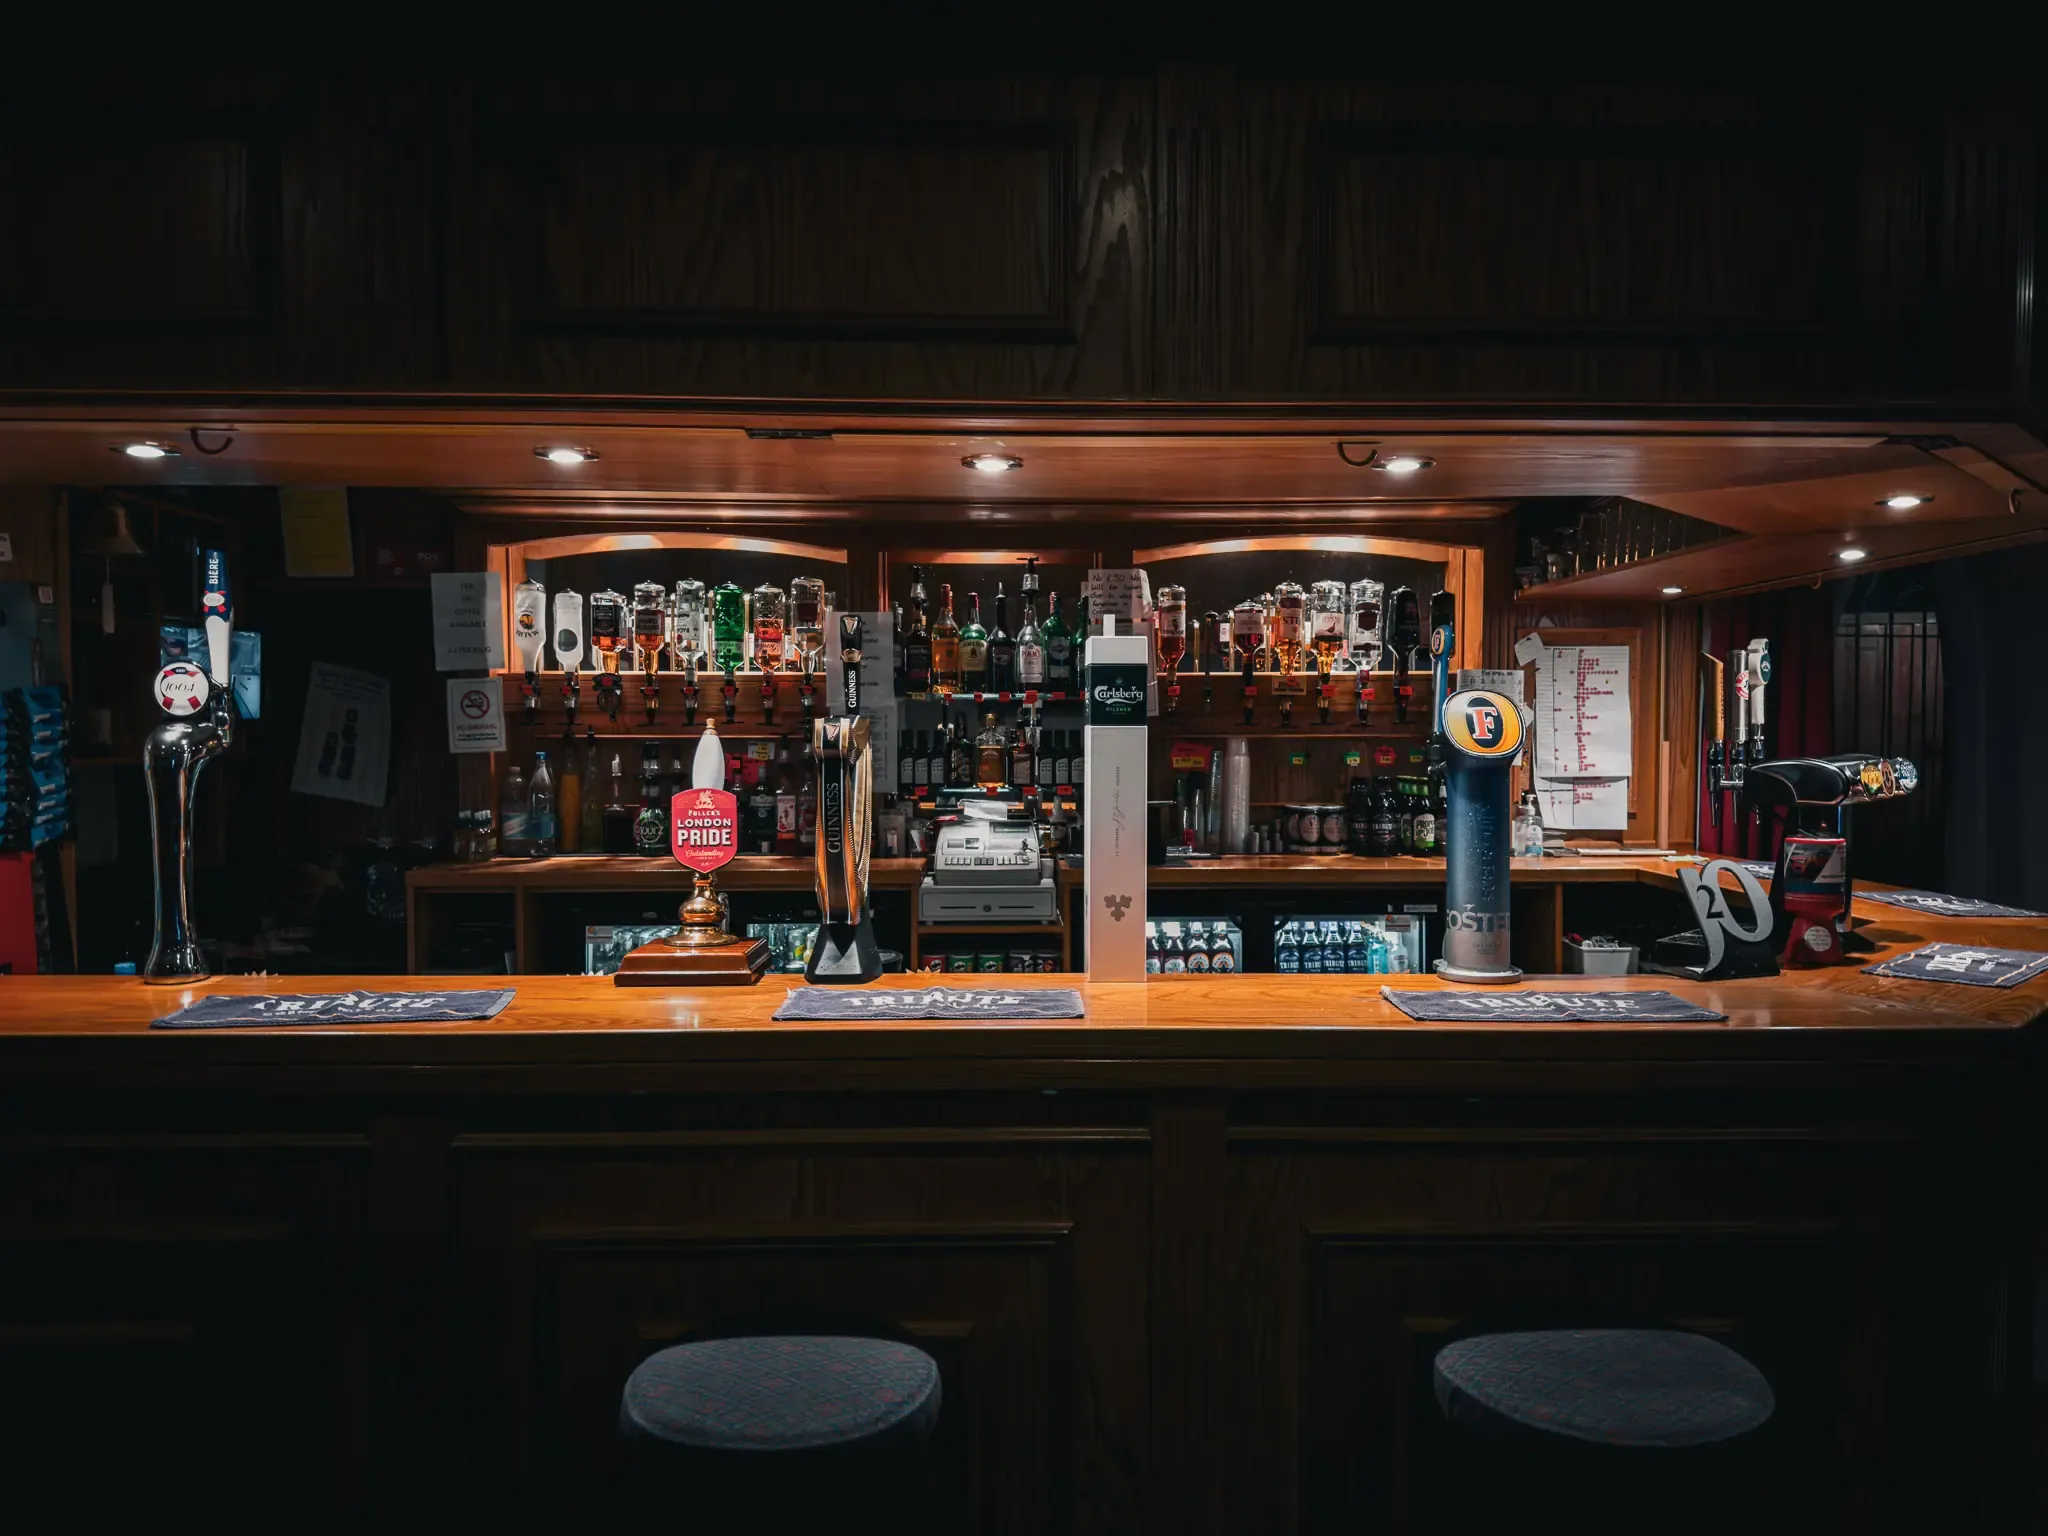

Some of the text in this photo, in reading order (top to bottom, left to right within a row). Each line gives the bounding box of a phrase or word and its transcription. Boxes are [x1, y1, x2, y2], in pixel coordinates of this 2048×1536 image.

[208, 558, 219, 585] BIÈRE
[848, 670, 857, 708] GUINNESS
[1094, 685, 1144, 704] Carlsberg
[1467, 706, 1498, 739] F
[677, 818, 732, 828] LONDON
[827, 782, 840, 853] GUINNESS
[677, 829, 732, 846] PRIDE
[685, 849, 724, 857] Outstanding
[1446, 910, 1510, 933] OSTE
[1448, 994, 1640, 1010] TRIBUTE
